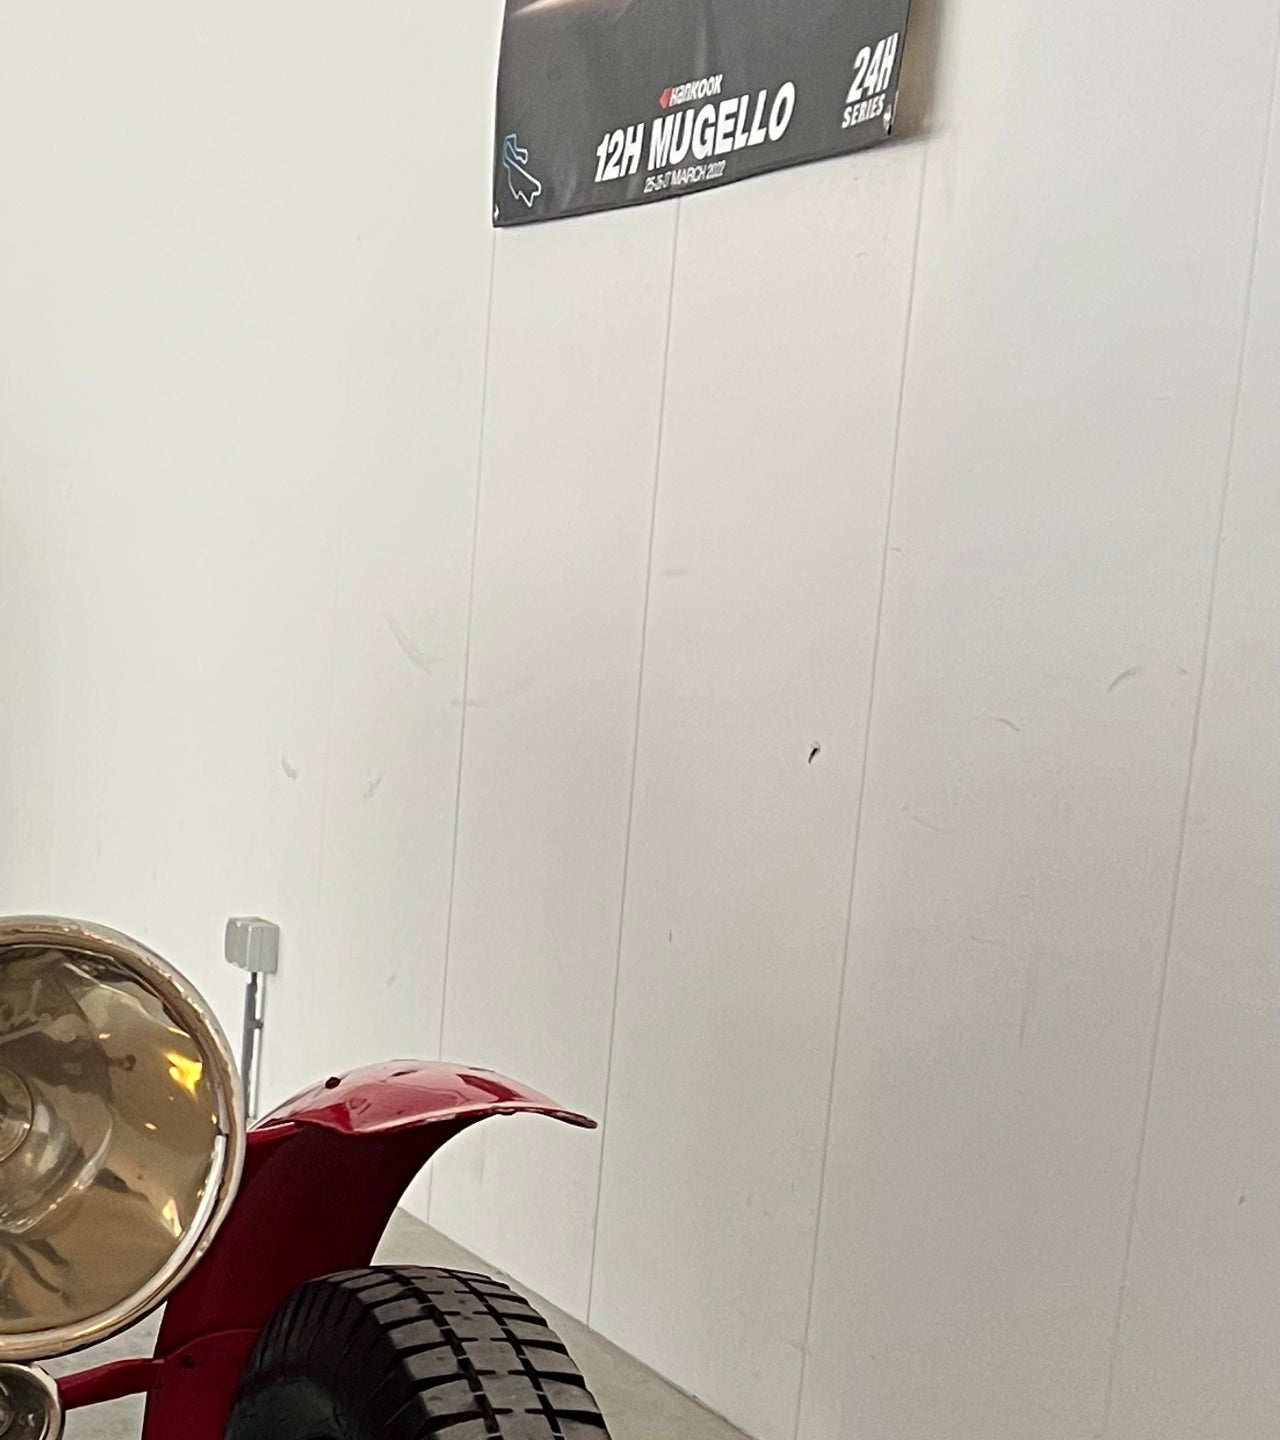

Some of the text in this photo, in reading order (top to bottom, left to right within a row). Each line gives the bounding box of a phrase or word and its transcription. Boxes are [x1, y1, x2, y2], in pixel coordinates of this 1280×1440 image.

[846, 32, 899, 104] 24H
[594, 81, 795, 182] 12H MUGELLO
[841, 93, 886, 128] SERIES
[671, 164, 707, 185] MARCH
